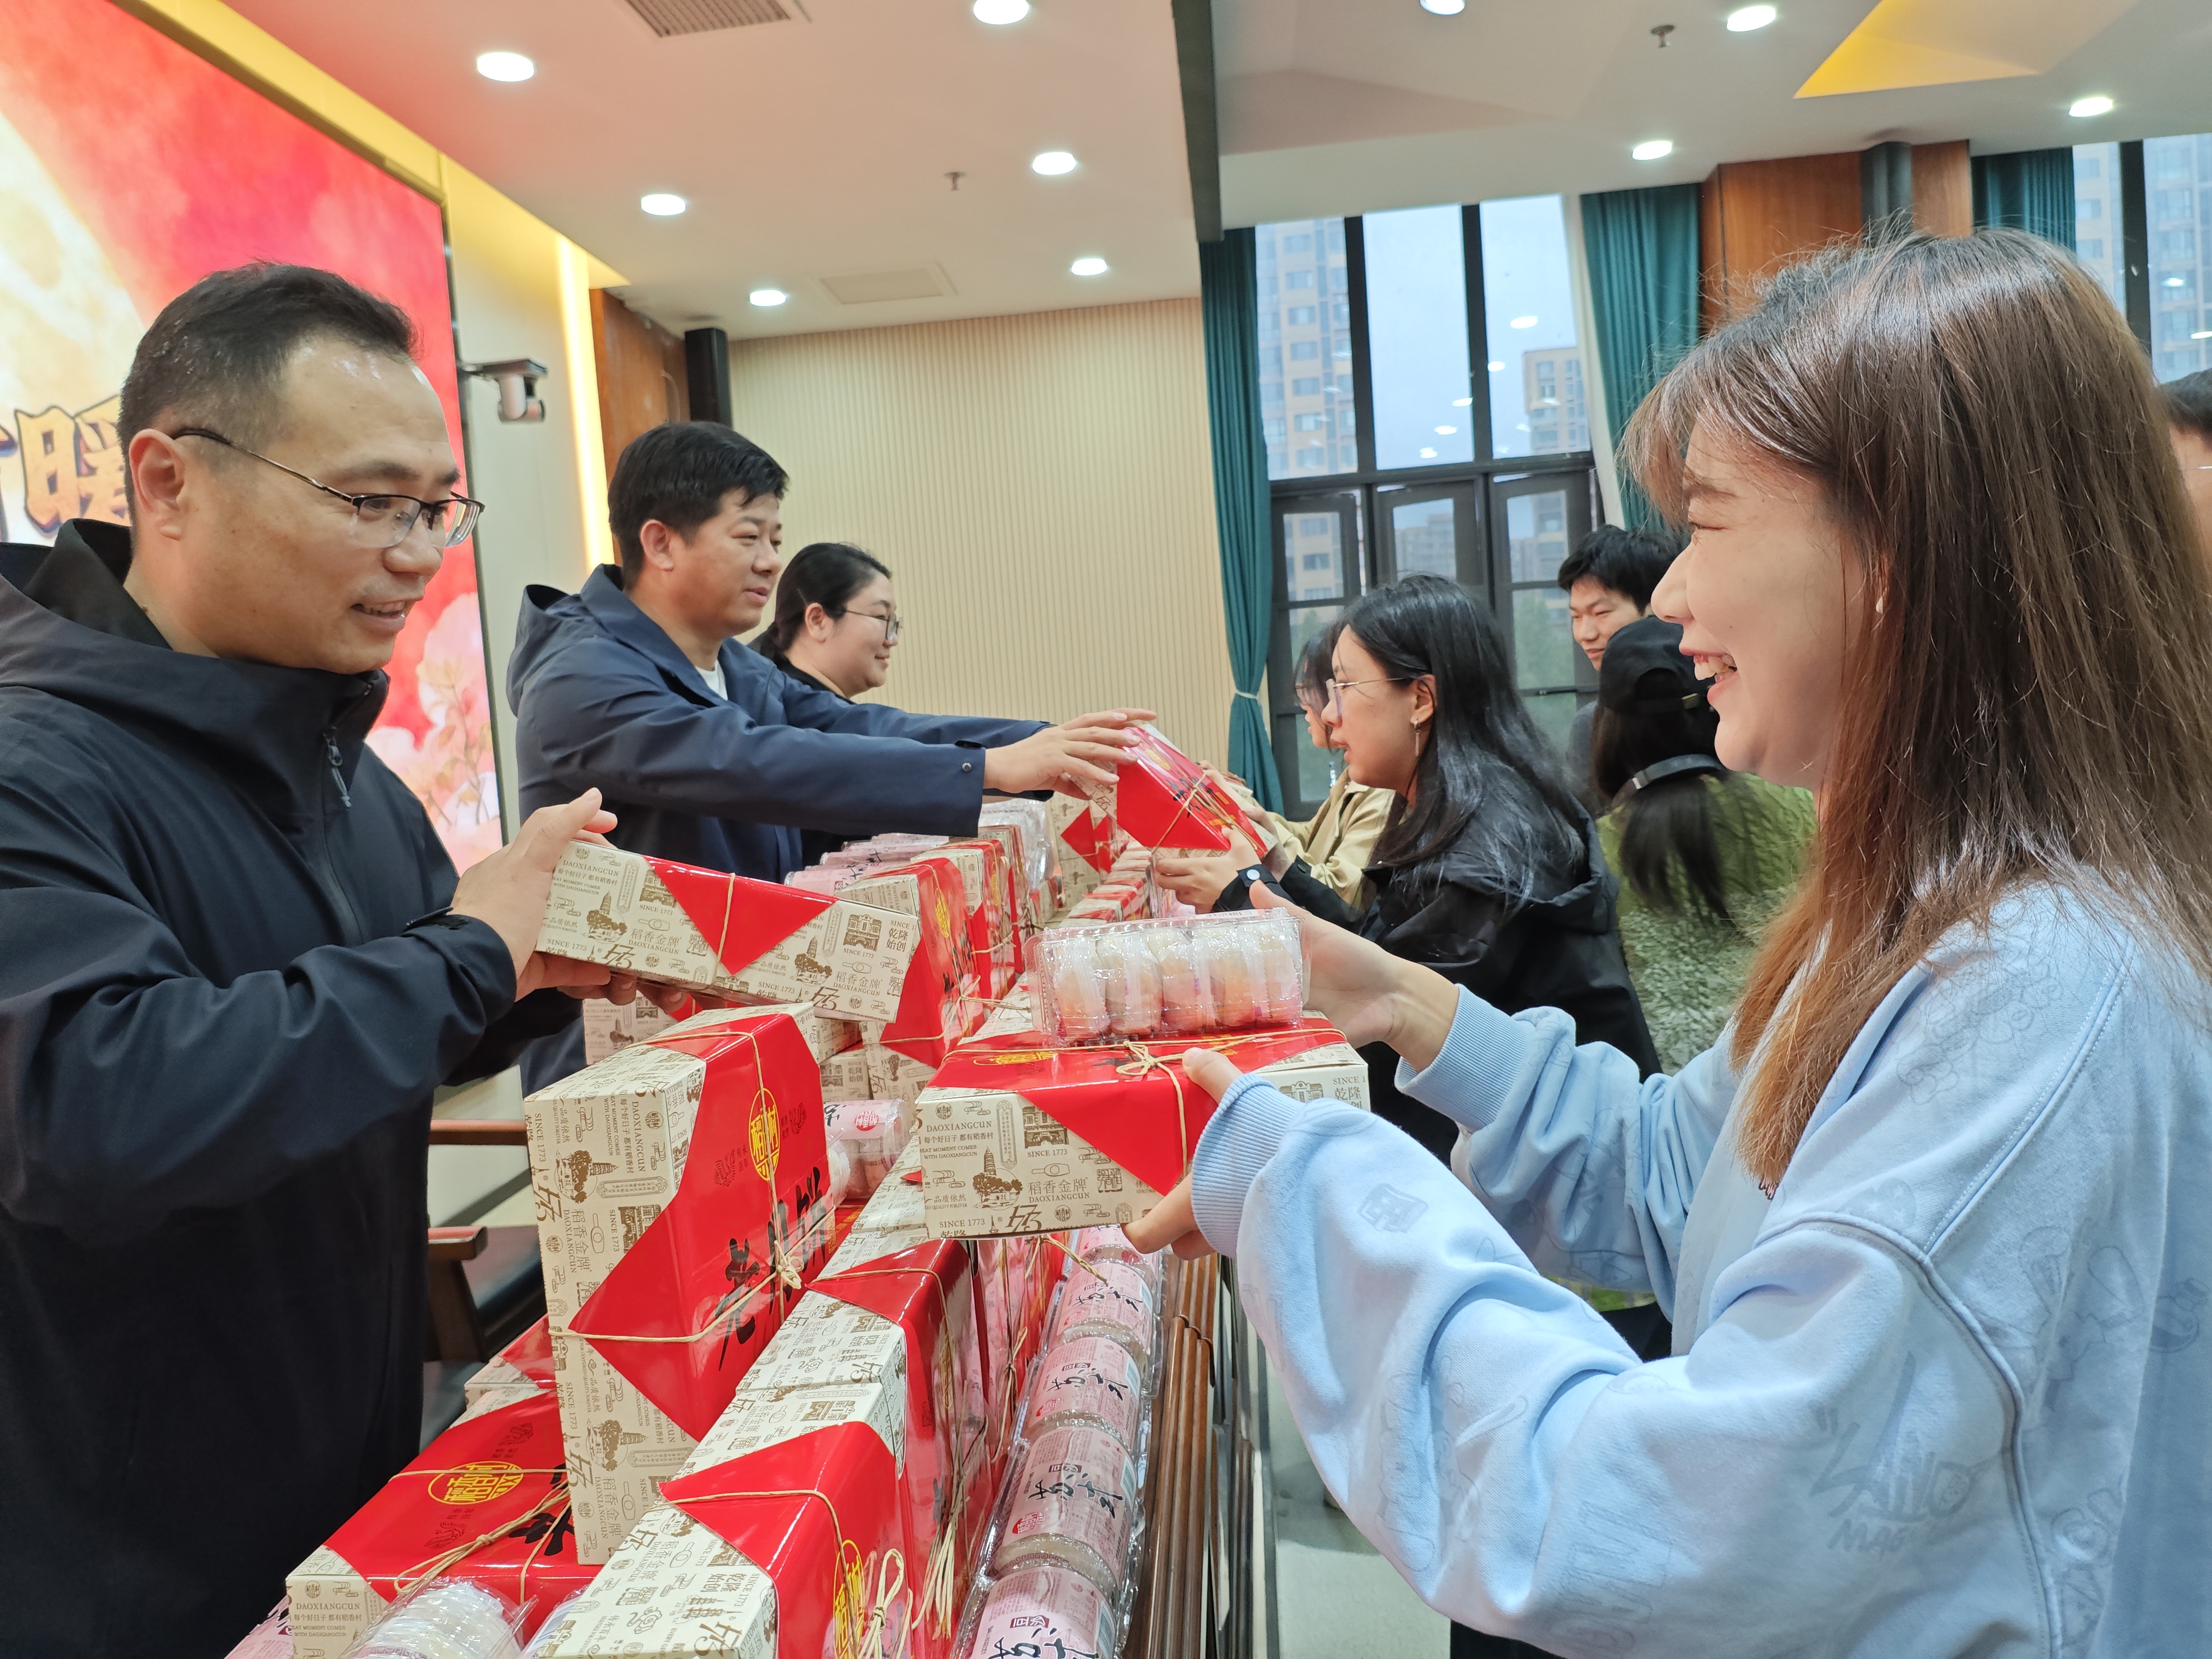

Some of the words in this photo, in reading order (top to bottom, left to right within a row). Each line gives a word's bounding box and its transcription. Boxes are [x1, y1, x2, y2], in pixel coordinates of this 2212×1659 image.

[563, 860, 619, 876] DAOXIANGCUN
[558, 868, 587, 879] 每个好日子
[588, 873, 618, 886] 都有稻香村
[567, 885, 599, 895] DAOXIANGCUN
[891, 920, 911, 929] SINCE
[547, 938, 569, 947] SINCE
[631, 928, 679, 947] 稻香金牌
[888, 928, 908, 941] 乾隆
[628, 940, 679, 954] DAOXIANGCUN
[843, 948, 861, 956] SINCE
[886, 939, 907, 952] 始创
[759, 981, 779, 990] SINCE
[781, 986, 795, 994] 1773
[833, 982, 880, 996] DAOXIANGCUN
[835, 972, 880, 989] 稻香金牌
[1333, 1076, 1359, 1085] SINCE
[1334, 1086, 1361, 1100] 乾隆
[619, 1098, 630, 1135] 每个好日子
[535, 1113, 544, 1141] SINCE
[560, 1108, 570, 1143] 品质依然
[927, 1121, 992, 1132] DAOXIANGCUN
[605, 1115, 613, 1156] DAOXIANGCUN
[632, 1101, 646, 1172] DAOXIANGCUN
[924, 1134, 958, 1143] 每个好日子
[960, 1132, 993, 1141] 都有稻香村
[538, 1143, 546, 1162] 1773
[623, 1137, 633, 1173] 都有稻香村
[1028, 1178, 1087, 1195] 稻香金牌
[934, 1193, 967, 1203] 品质依然
[1029, 1192, 1090, 1203] DAOXIANGCUN
[609, 1210, 617, 1234] SINCE
[968, 1218, 985, 1226] 1773
[563, 1209, 577, 1273] DAOXIANGCUN
[571, 1209, 590, 1272] 稻香金牌
[612, 1236, 620, 1252] 1773
[566, 1382, 575, 1409] SINCE
[590, 1378, 601, 1412] 品质依然
[569, 1412, 577, 1429] 1773
[653, 1409, 664, 1444] 都有稻香村
[639, 1478, 648, 1502] SINCE
[595, 1476, 608, 1539] DAOXIANGCUN
[602, 1476, 621, 1536] 稻香金牌
[703, 1539, 718, 1555] SINCE
[627, 1541, 662, 1582] DAOXIANGCUN
[639, 1540, 680, 1581] 稻香金牌
[695, 1555, 707, 1566] 1773
[700, 1573, 725, 1592] 始创
[720, 1573, 747, 1592] 乾隆
[744, 1573, 761, 1592] SINCE
[734, 1594, 750, 1607] 1773
[594, 1615, 620, 1642] 传承百年
[664, 1628, 678, 1643] EVERY
